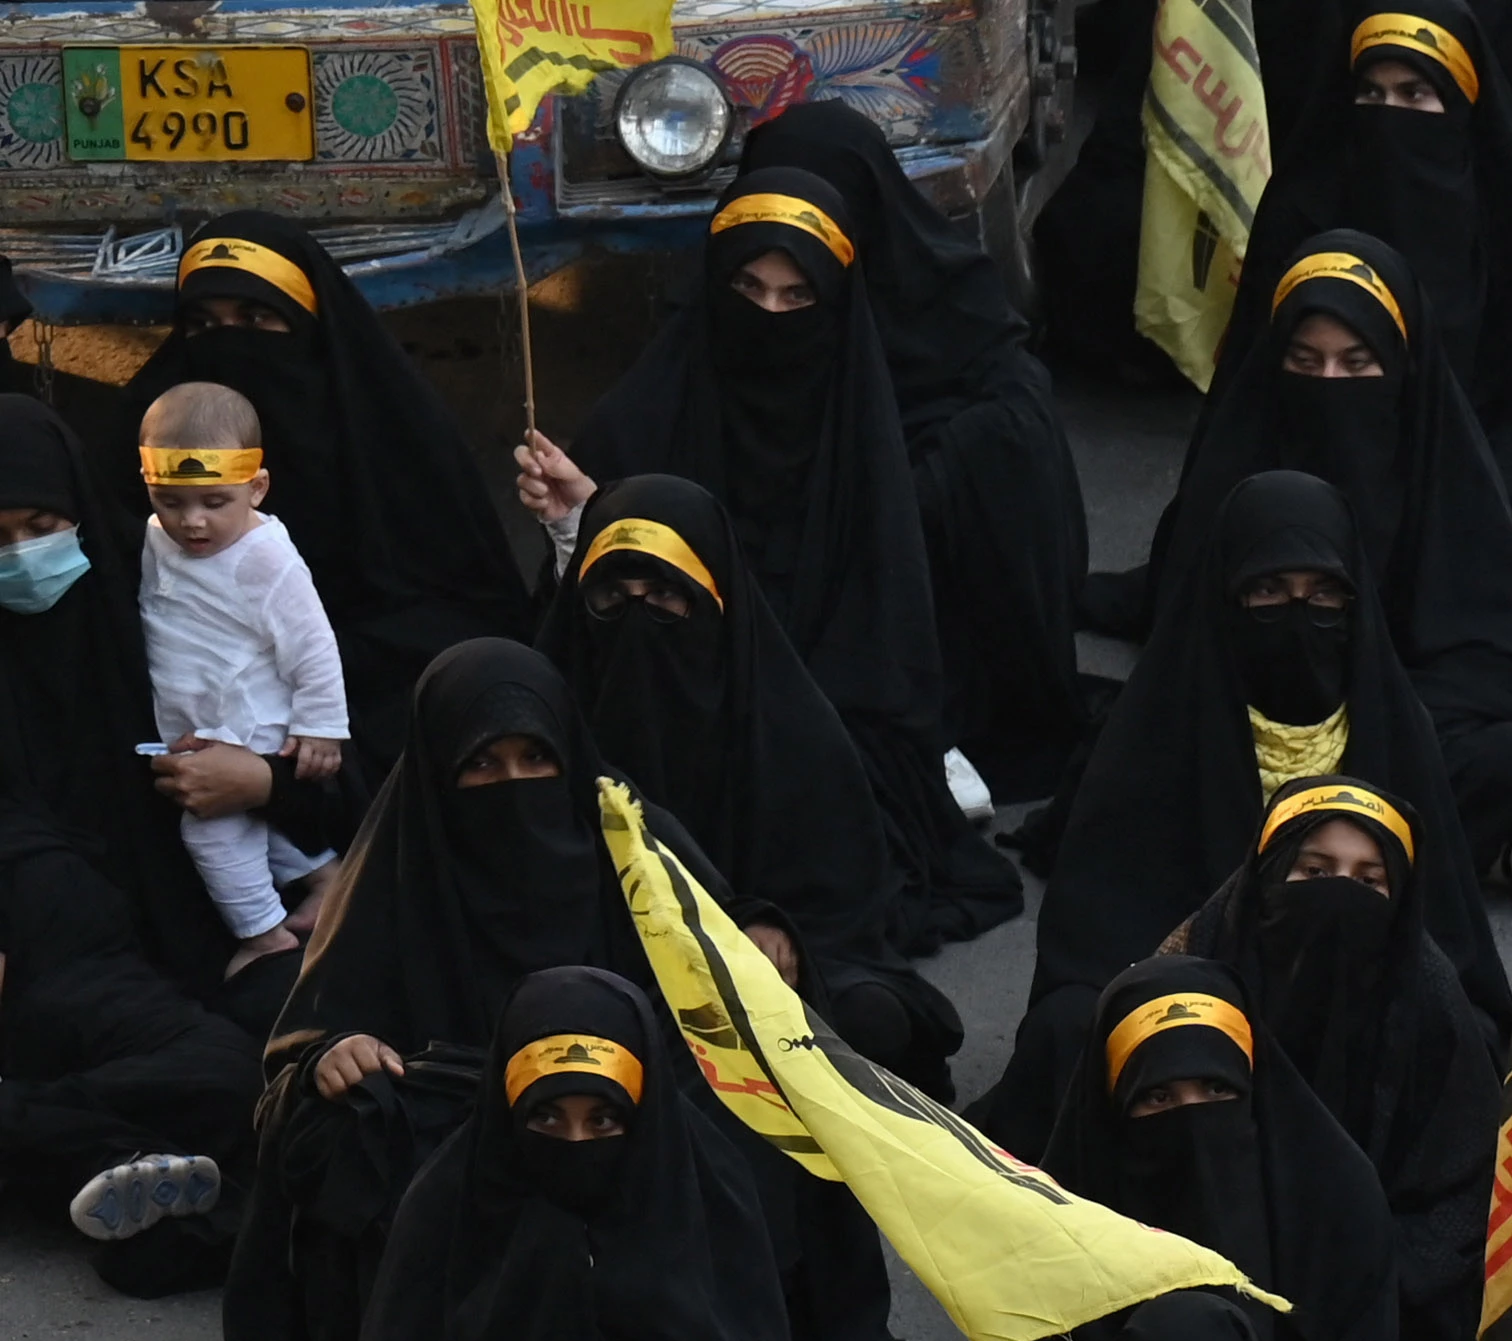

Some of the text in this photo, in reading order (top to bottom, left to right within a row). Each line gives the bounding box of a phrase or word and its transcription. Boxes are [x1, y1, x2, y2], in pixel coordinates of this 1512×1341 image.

[139, 58, 233, 98] KSA
[73, 139, 120, 150] PUNJAB
[131, 110, 249, 151] 4990
